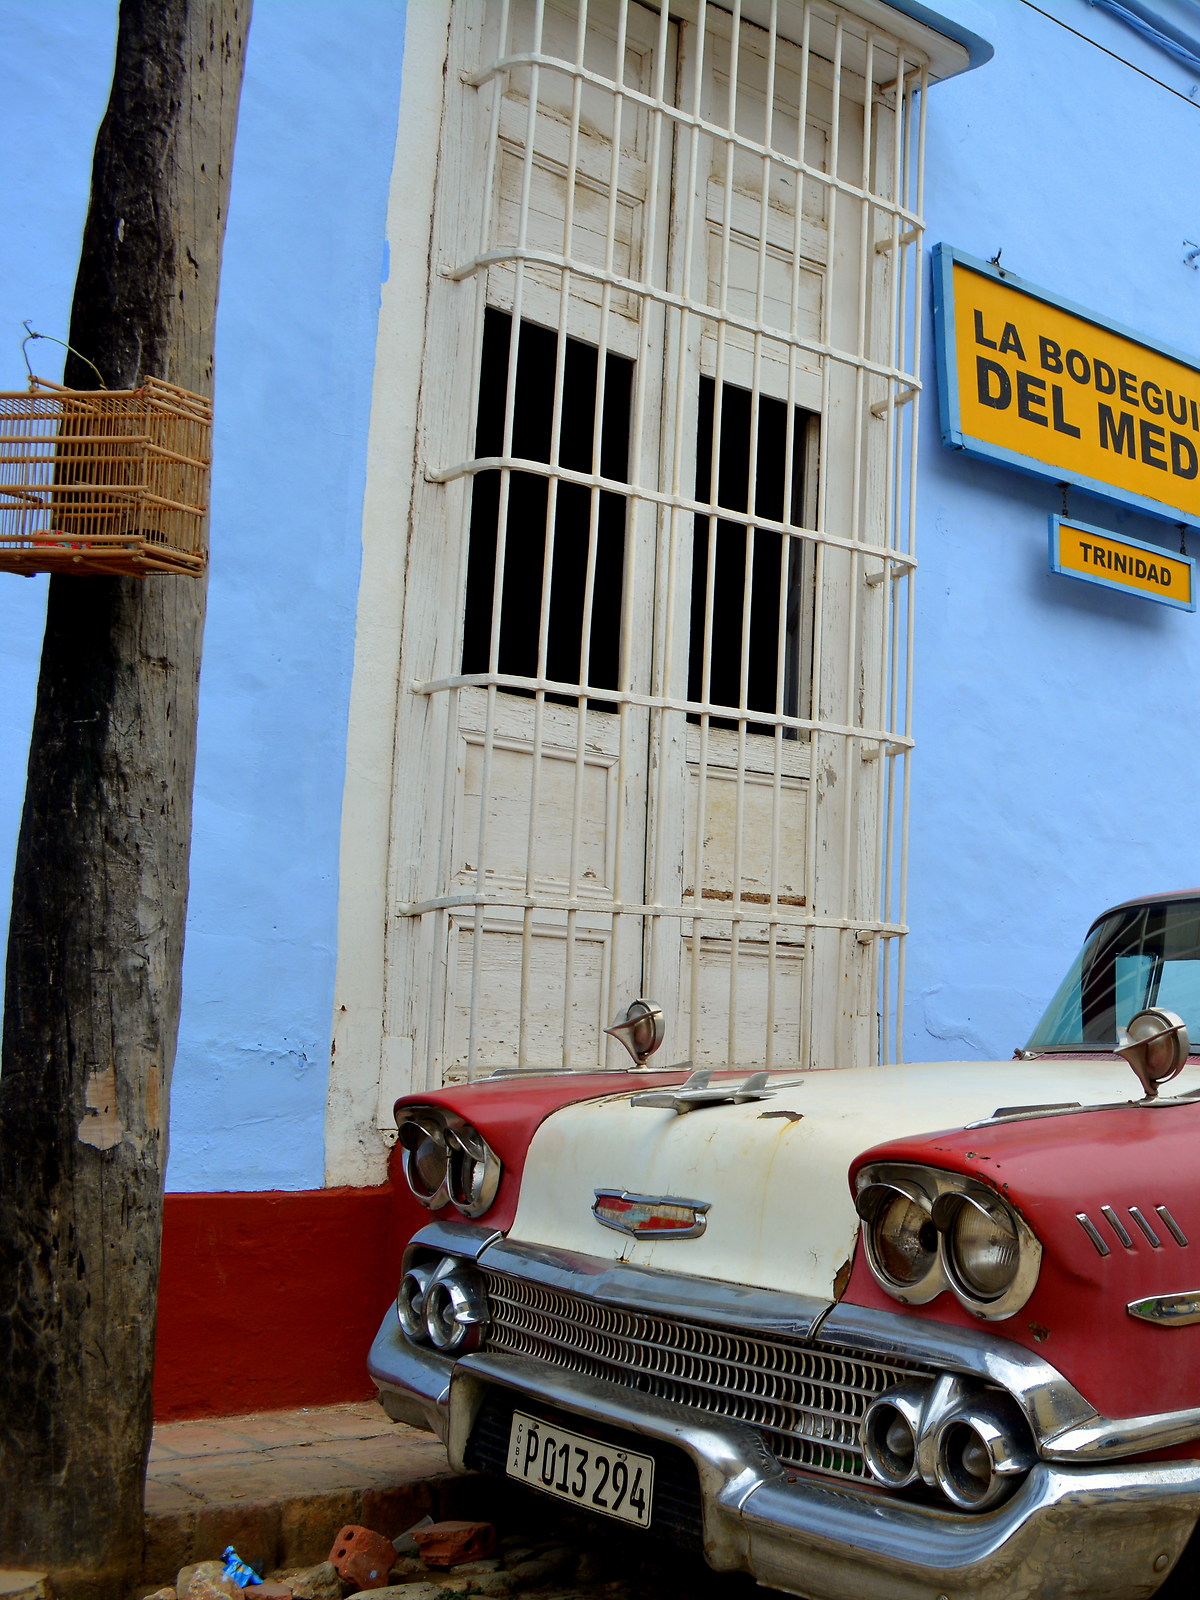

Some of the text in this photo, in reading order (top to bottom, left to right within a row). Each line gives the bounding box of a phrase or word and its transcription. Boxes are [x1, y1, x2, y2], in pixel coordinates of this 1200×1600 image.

[973, 308, 1027, 363] LA
[975, 354, 1082, 440] DEL
[1079, 541, 1173, 587] TRINIDAD
[513, 1423, 524, 1468] CUBA
